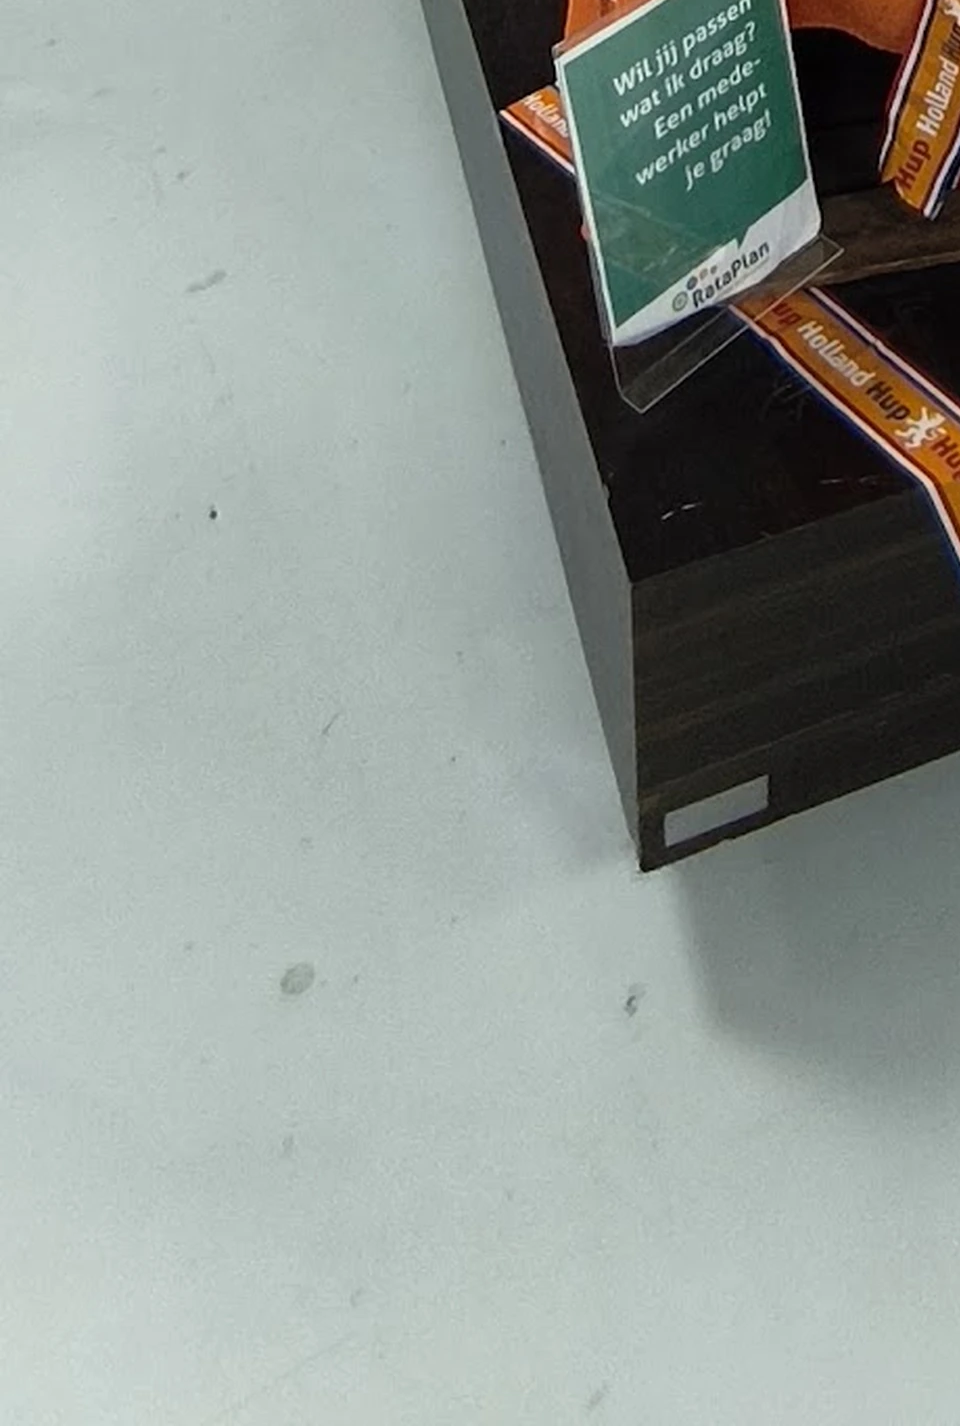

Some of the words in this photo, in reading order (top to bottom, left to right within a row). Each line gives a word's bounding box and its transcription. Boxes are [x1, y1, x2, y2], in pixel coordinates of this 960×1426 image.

[612, 57, 652, 97] Wil
[655, 40, 679, 77] jij
[620, 89, 661, 128] wat
[665, 73, 686, 97] ik
[689, 21, 756, 80] draag?
[654, 103, 693, 140] Een
[697, 58, 761, 109] mede-
[635, 123, 709, 185] werker
[713, 82, 768, 132] helpt
[685, 161, 706, 192] je
[710, 108, 772, 173] graag!
[896, 140, 933, 190] Hup
[916, 56, 960, 138] Holland
[692, 241, 770, 308] RataPlan
[797, 320, 877, 387] Holland
[865, 380, 911, 420] Hup
